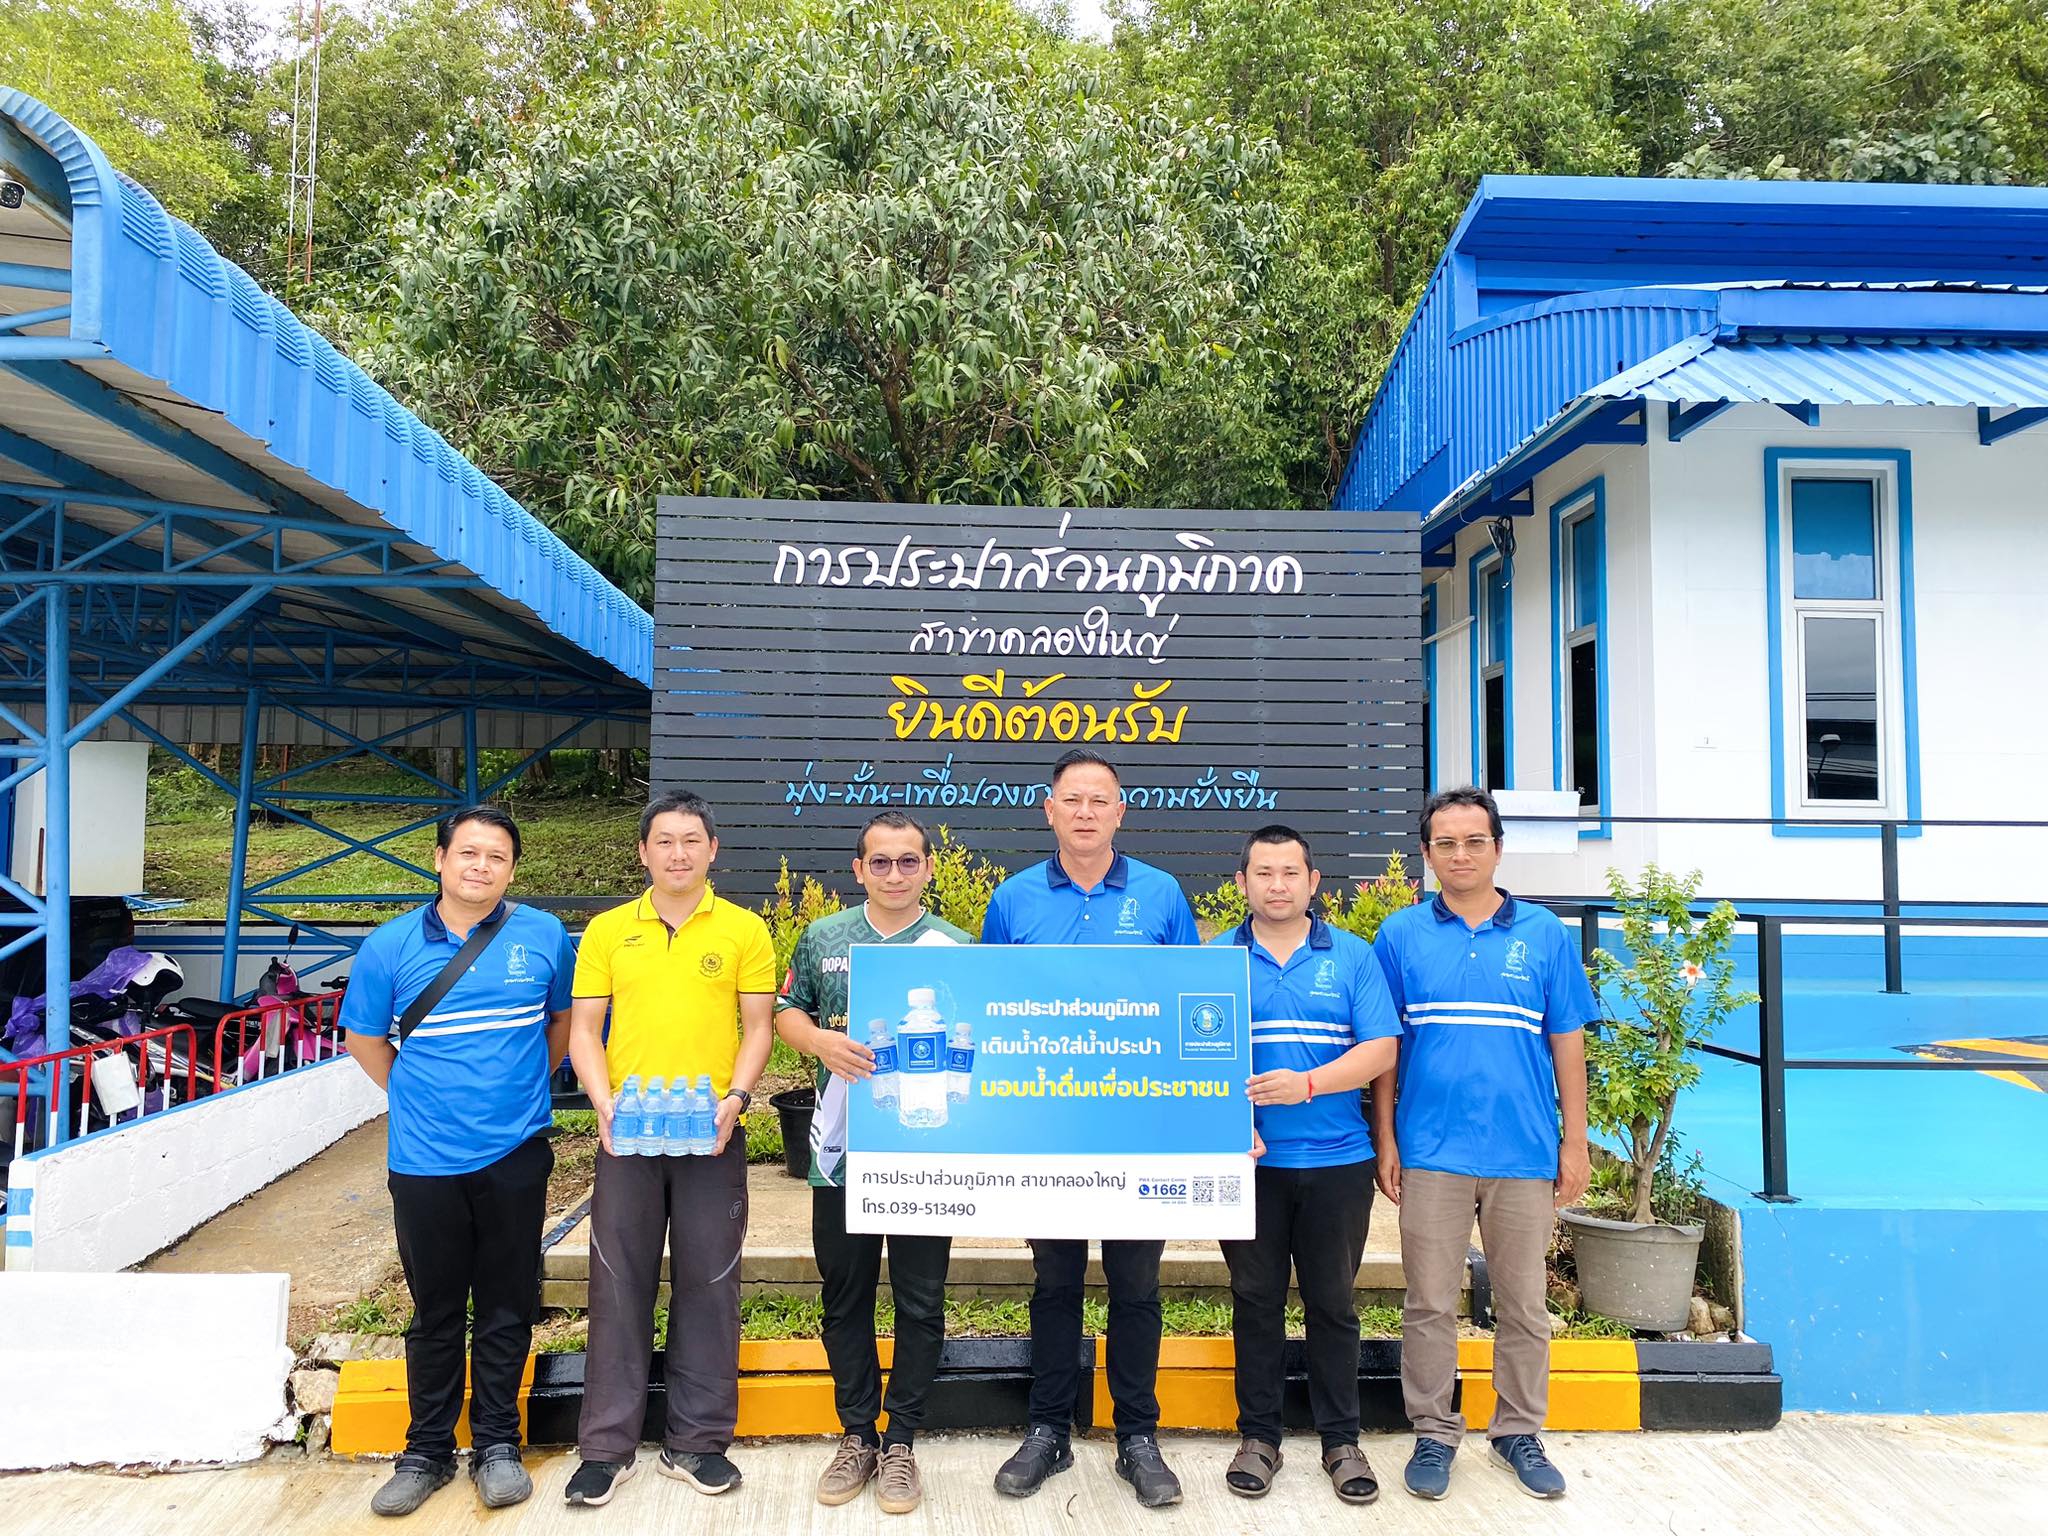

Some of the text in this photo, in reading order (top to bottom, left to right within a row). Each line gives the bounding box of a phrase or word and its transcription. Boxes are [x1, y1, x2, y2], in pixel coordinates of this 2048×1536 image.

[772, 511, 1303, 618] การประปาส่วนภูมิภาค
[908, 605, 1180, 664] สาขาคลองใหญ่
[887, 668, 1189, 743] ยินดีต้อนรับ
[986, 997, 1160, 1021] การประปาส่วนภูมิภาค
[980, 1066, 1230, 1097] มอบน้ำดื่มเพื่อประชาชน
[862, 1168, 1126, 1191] การประปาส่วนภูมิภาค สาขาคลองใหญ่
[1151, 1183, 1187, 1196] 1662
